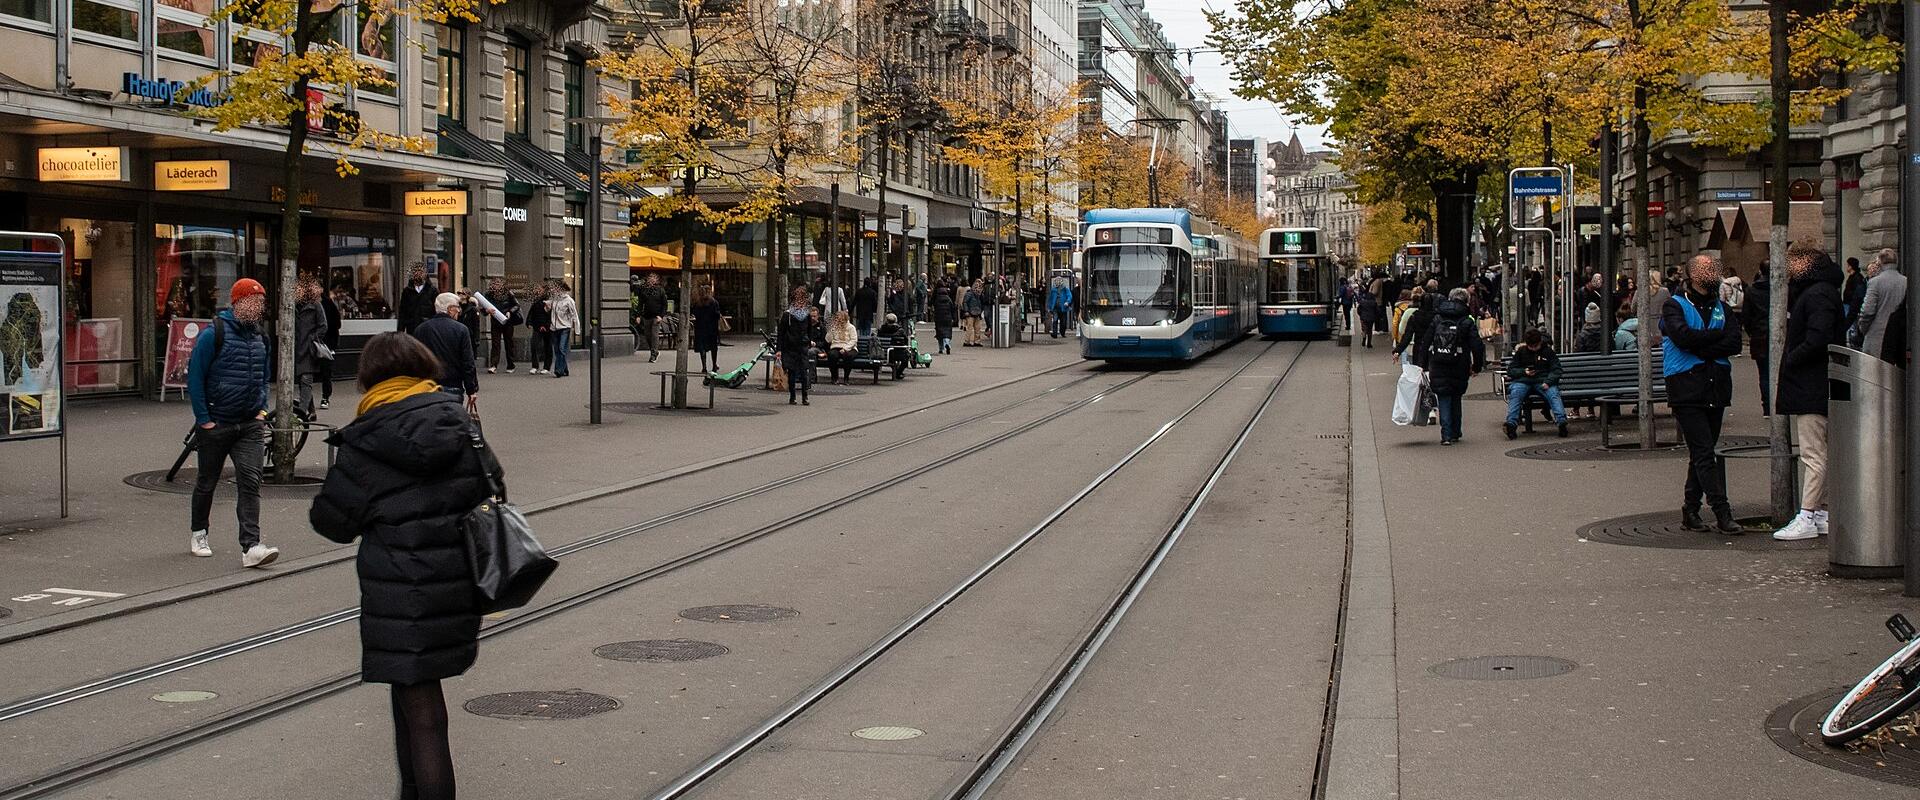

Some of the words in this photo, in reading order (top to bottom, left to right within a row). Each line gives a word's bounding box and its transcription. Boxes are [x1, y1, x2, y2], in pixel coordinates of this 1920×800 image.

[42, 157, 118, 172] chocoatelier
[166, 166, 218, 179] Läderach
[415, 195, 457, 206] Läderach
[1102, 230, 1110, 240] 6
[1287, 232, 1298, 243] 11
